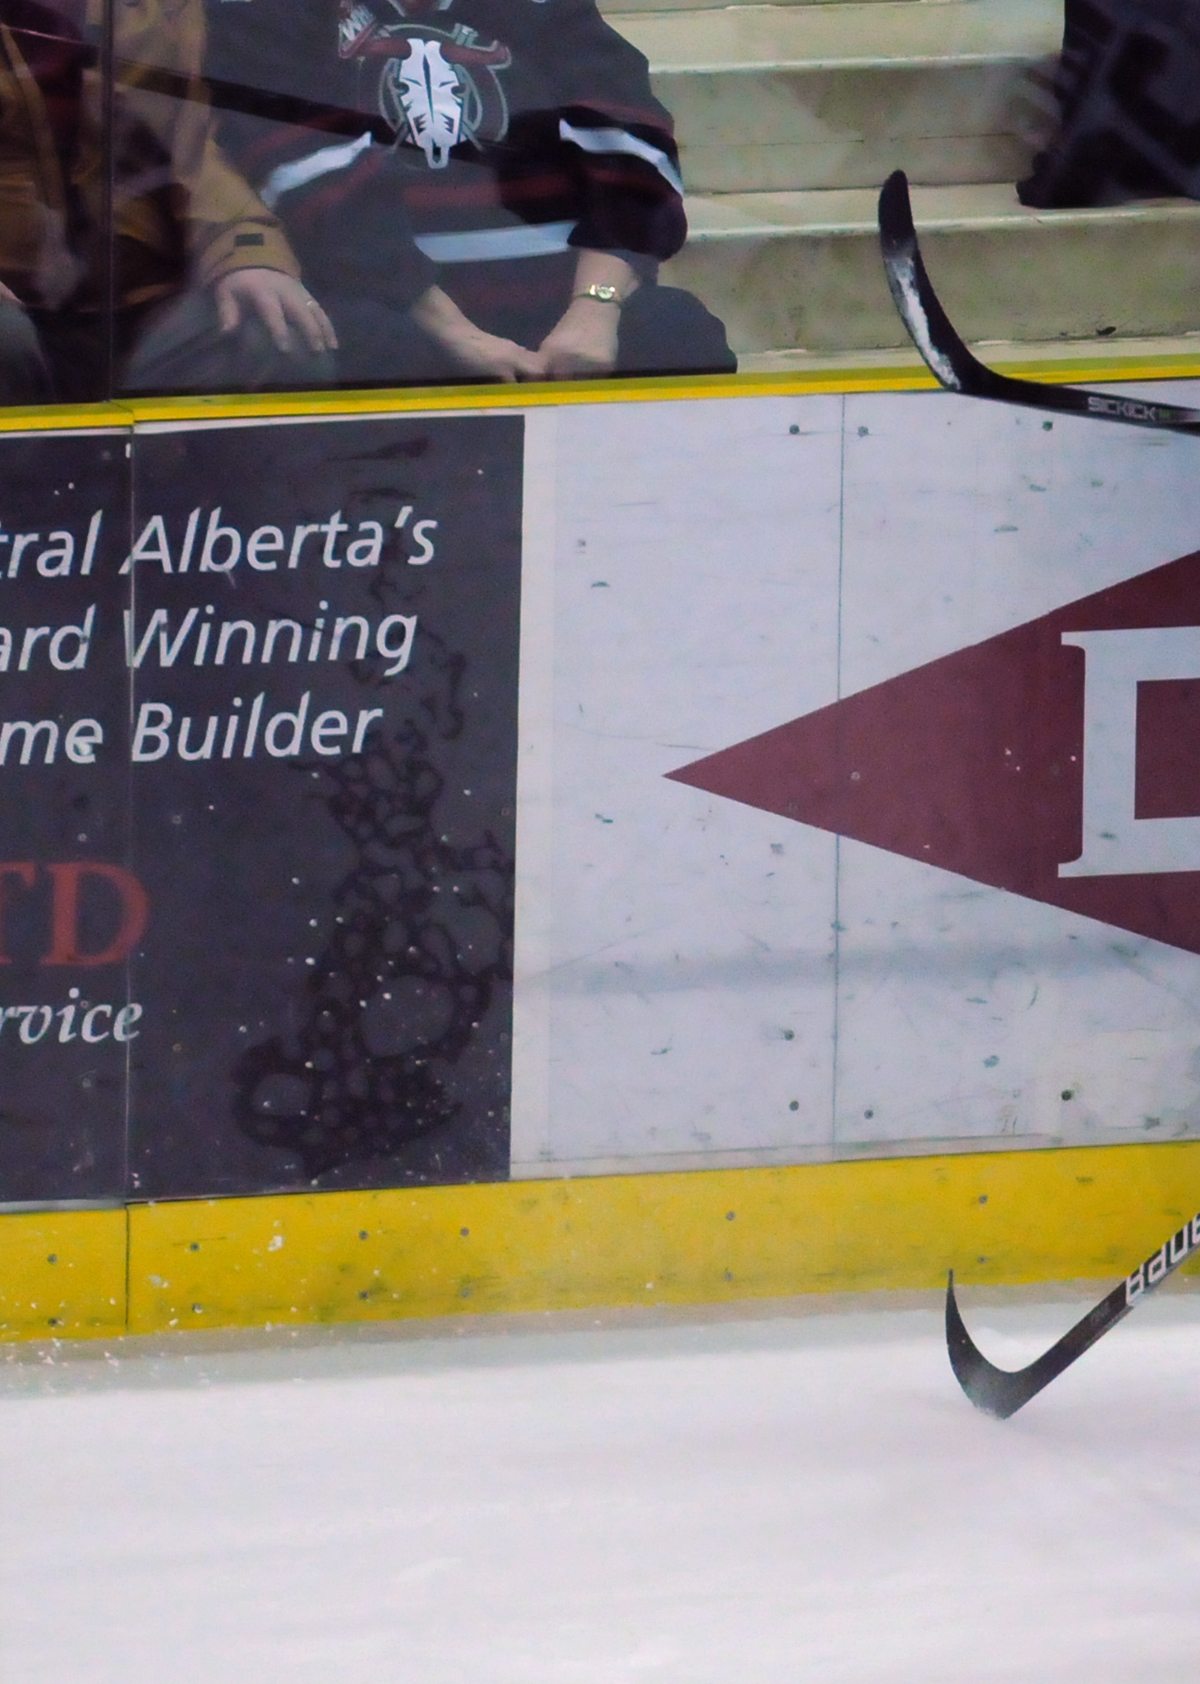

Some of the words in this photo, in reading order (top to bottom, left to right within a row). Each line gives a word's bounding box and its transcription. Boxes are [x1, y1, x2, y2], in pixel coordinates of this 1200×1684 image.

[118, 505, 438, 575] Alberta's
[123, 600, 418, 676] Winning
[131, 690, 383, 762] Builder
